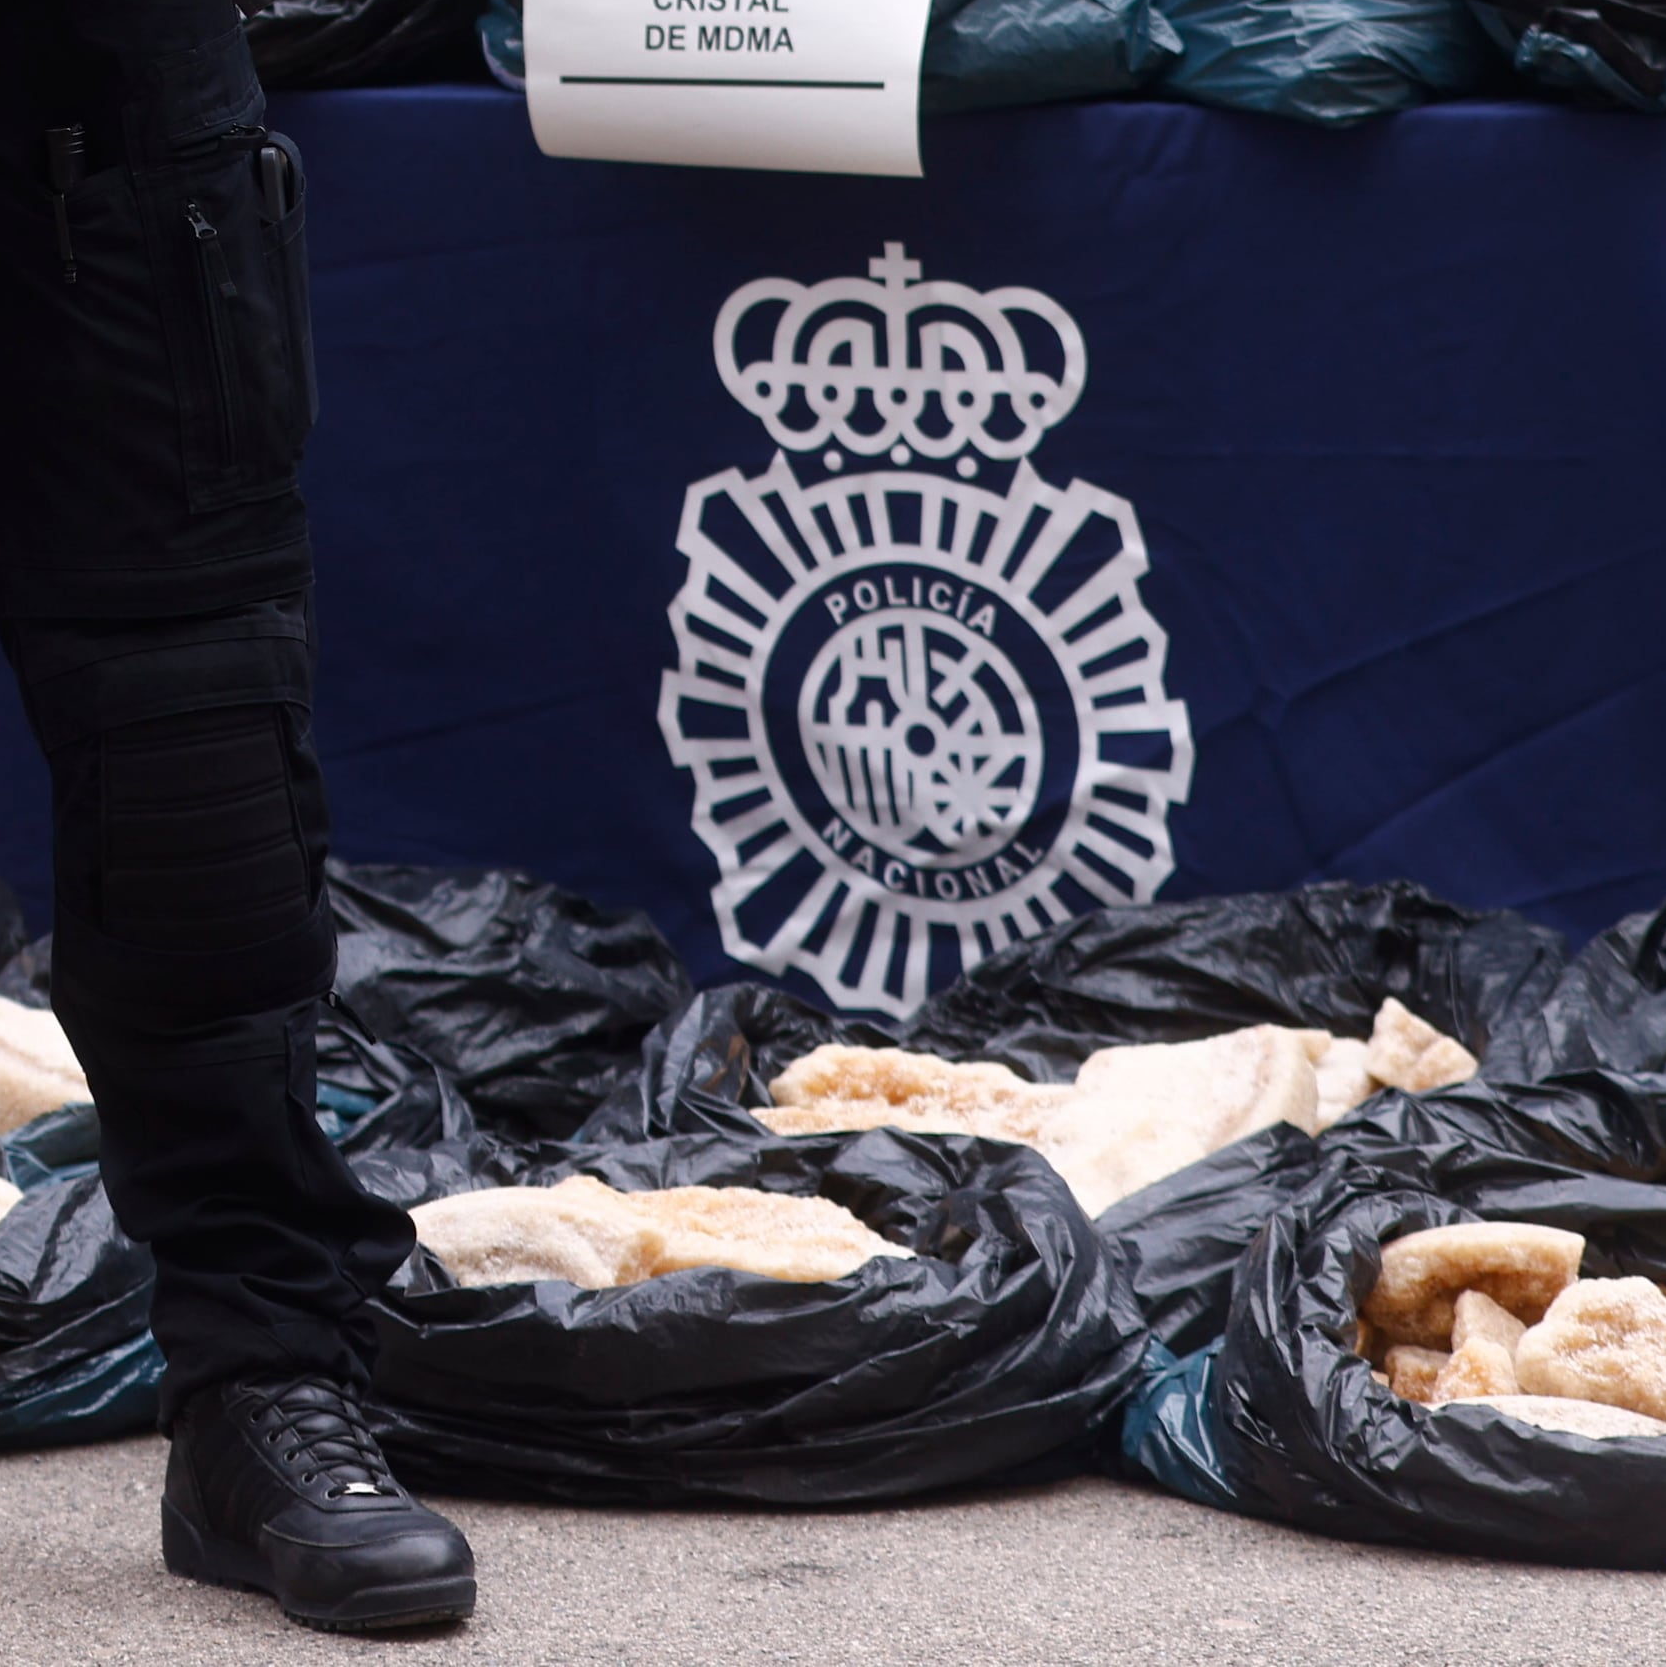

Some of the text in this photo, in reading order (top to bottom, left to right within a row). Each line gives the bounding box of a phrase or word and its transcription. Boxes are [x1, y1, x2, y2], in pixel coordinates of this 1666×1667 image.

[644, 24, 794, 52] DE MDMA
[823, 576, 997, 637] POLICÍA
[822, 817, 1043, 901] NACIONAL
